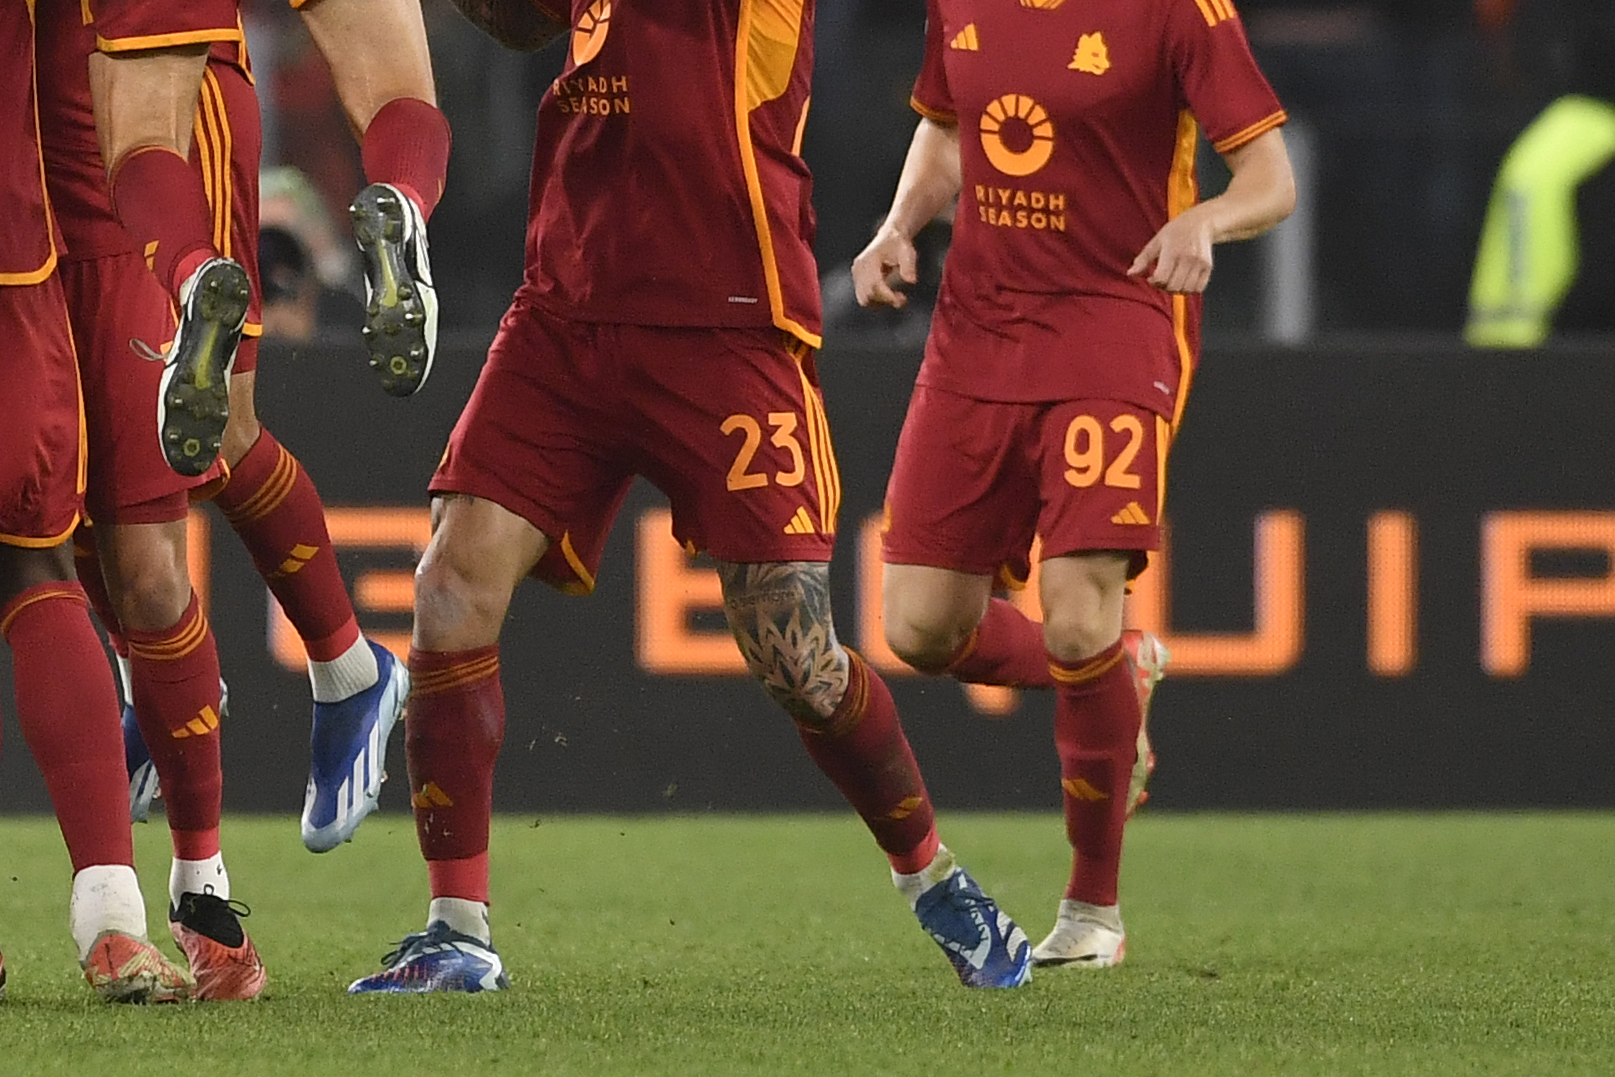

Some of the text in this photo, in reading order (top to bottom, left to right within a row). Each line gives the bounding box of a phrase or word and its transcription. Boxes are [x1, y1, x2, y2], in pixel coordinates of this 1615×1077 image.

[558, 96, 631, 116] SEASON
[975, 185, 1065, 211] RIYADH
[979, 206, 1065, 232] SEASON
[720, 412, 805, 491] 23
[1064, 414, 1143, 489] 92
